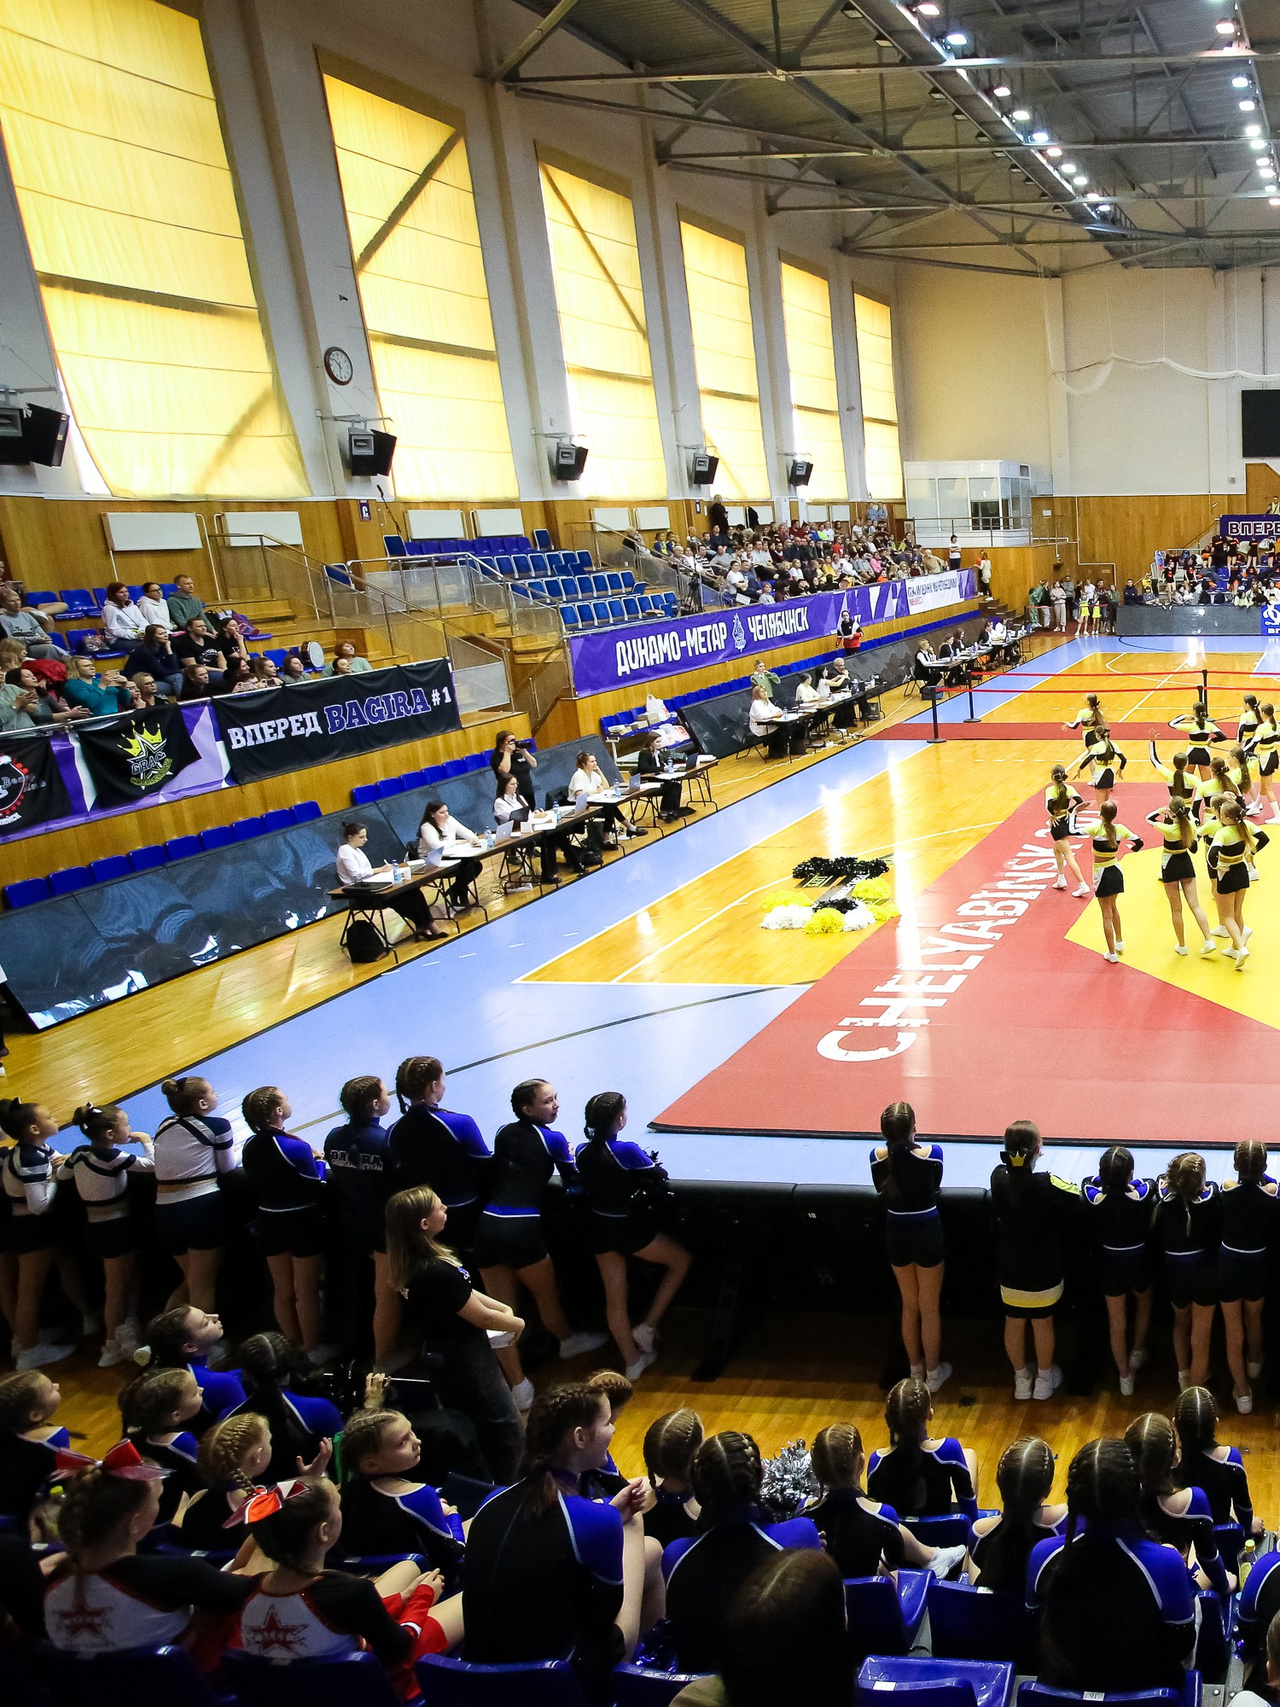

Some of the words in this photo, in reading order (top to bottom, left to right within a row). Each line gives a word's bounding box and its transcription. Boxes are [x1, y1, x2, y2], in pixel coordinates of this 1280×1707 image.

[615, 622, 728, 677] ДИНАМО-МЕТАР
[747, 606, 810, 642] ЧЕЛЯБИНСК
[227, 711, 323, 750] ВПЕРЕД
[323, 687, 431, 735] BAGIRA
